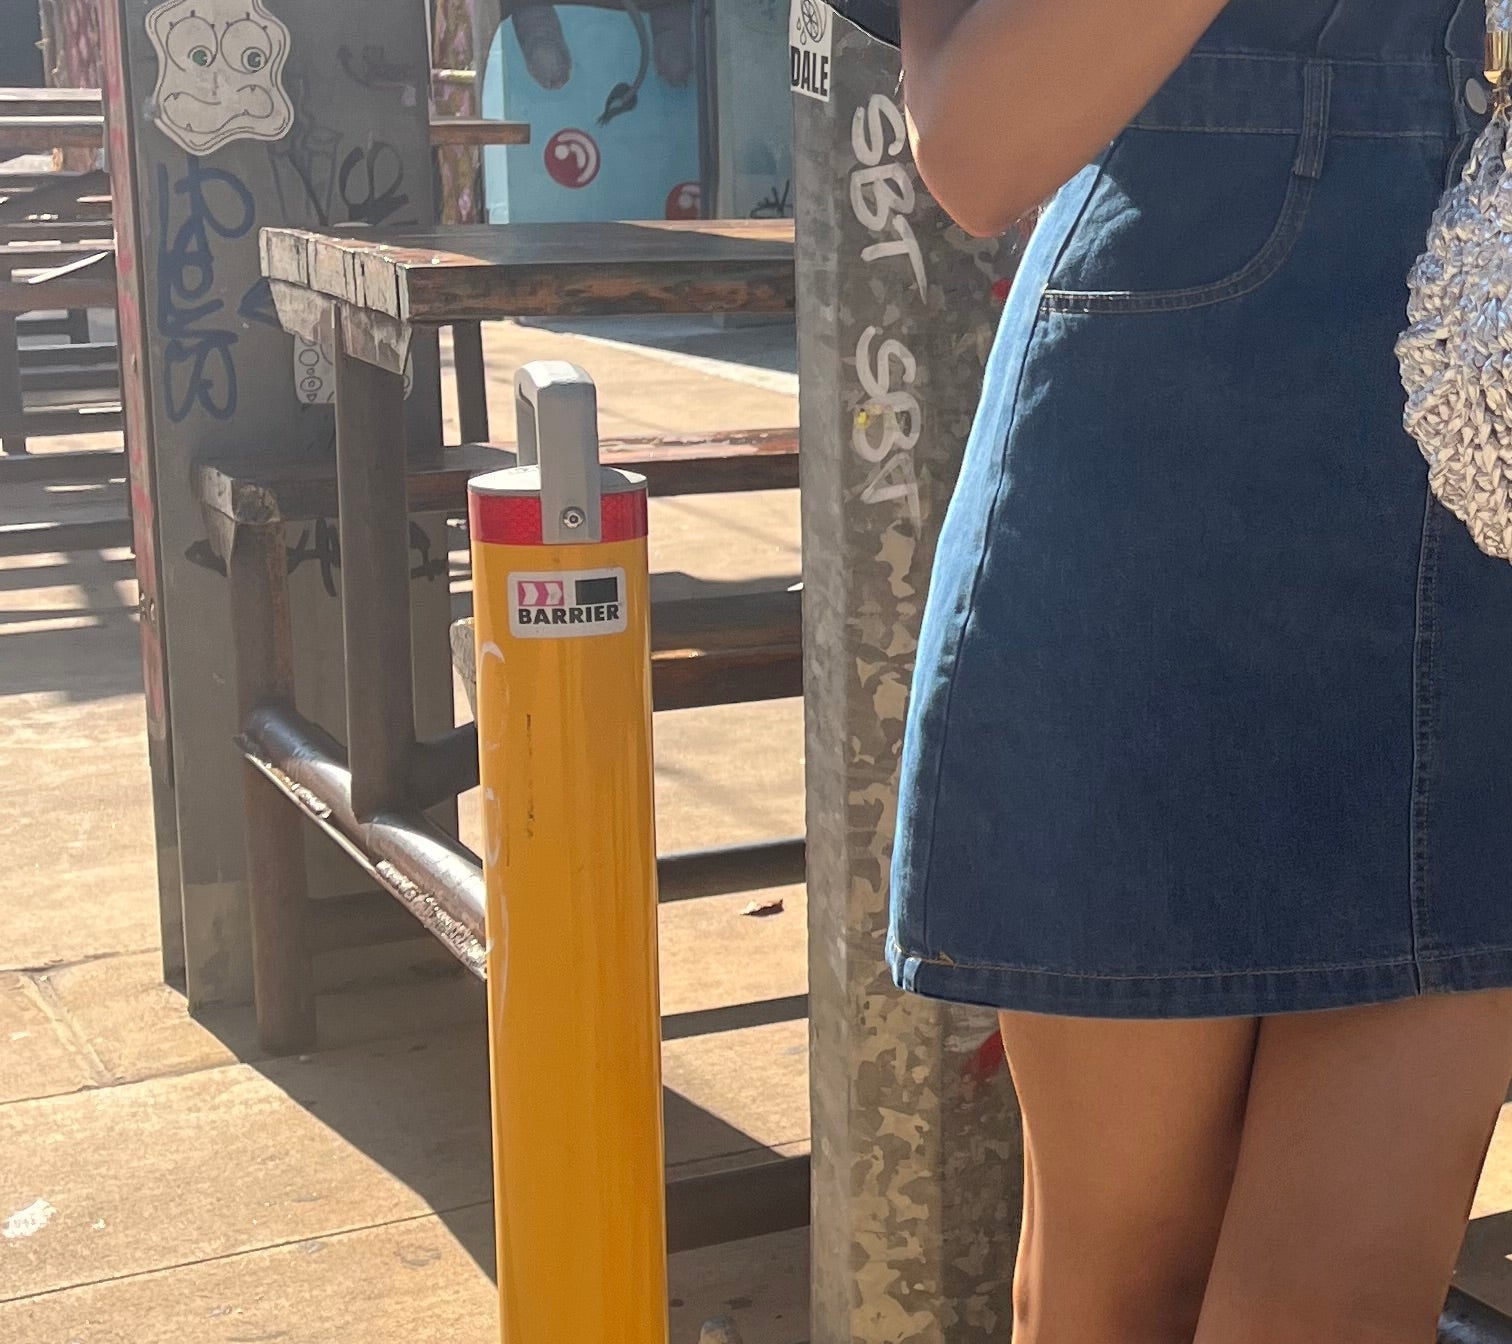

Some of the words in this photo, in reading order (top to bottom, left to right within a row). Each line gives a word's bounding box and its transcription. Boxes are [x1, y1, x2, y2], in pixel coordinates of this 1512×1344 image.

[790, 45, 829, 97] DALE
[850, 93, 928, 305] SBT
[518, 604, 619, 624] BARRIER
